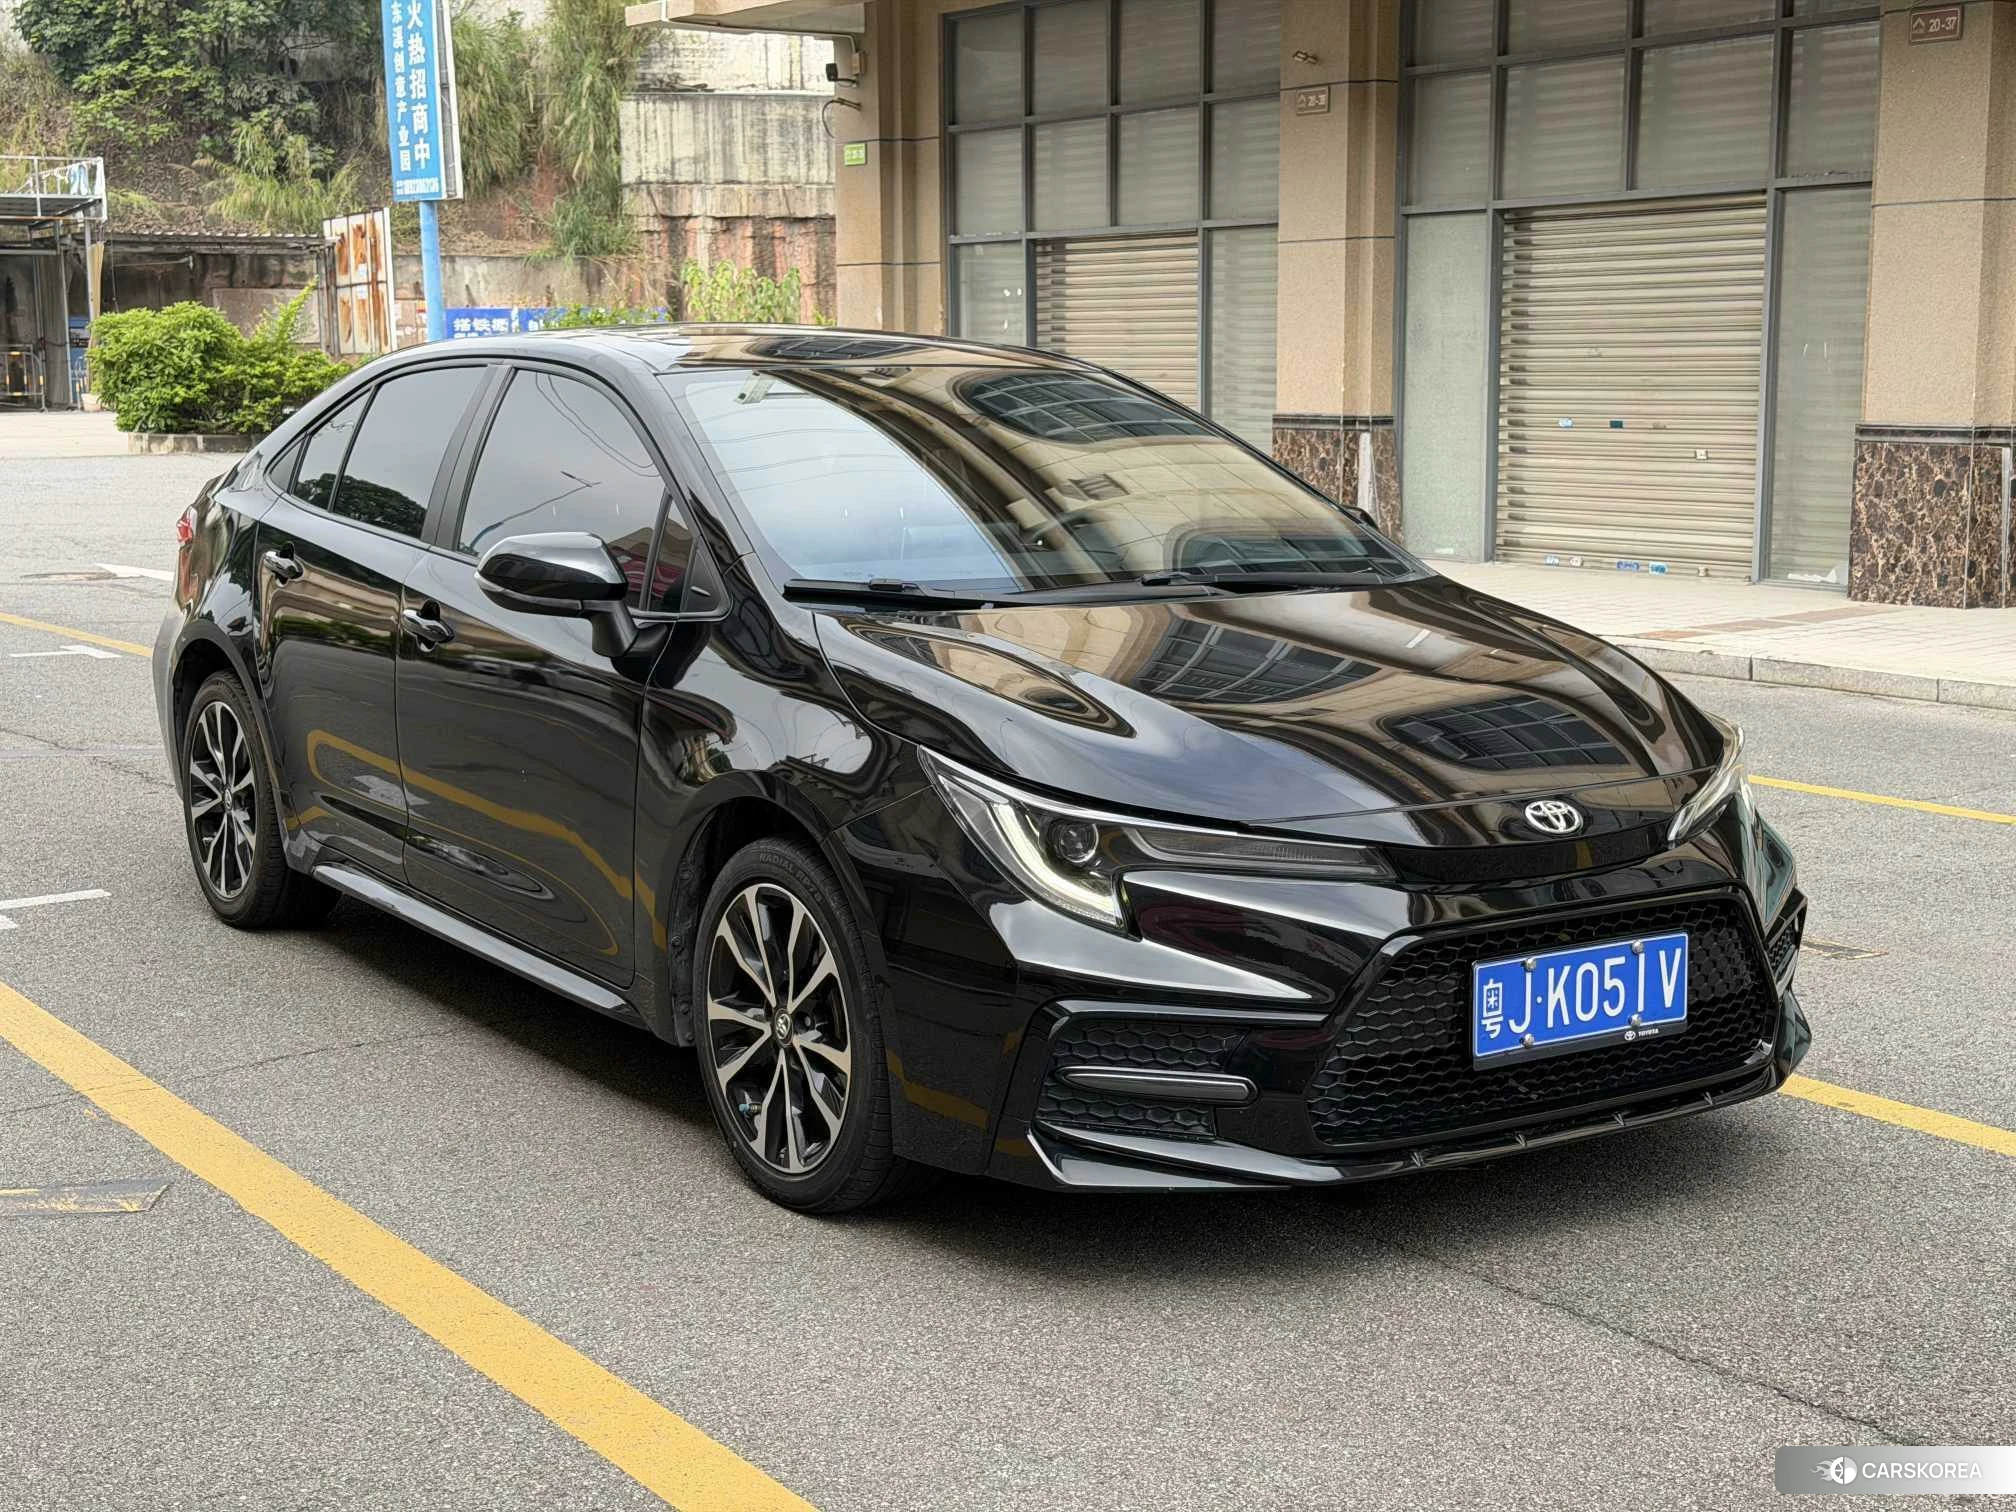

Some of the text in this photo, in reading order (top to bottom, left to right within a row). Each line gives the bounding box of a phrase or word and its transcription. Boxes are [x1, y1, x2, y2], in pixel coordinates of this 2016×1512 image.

[1928, 16, 1957, 32] 20-37
[407, 0, 430, 169] 火热招商中
